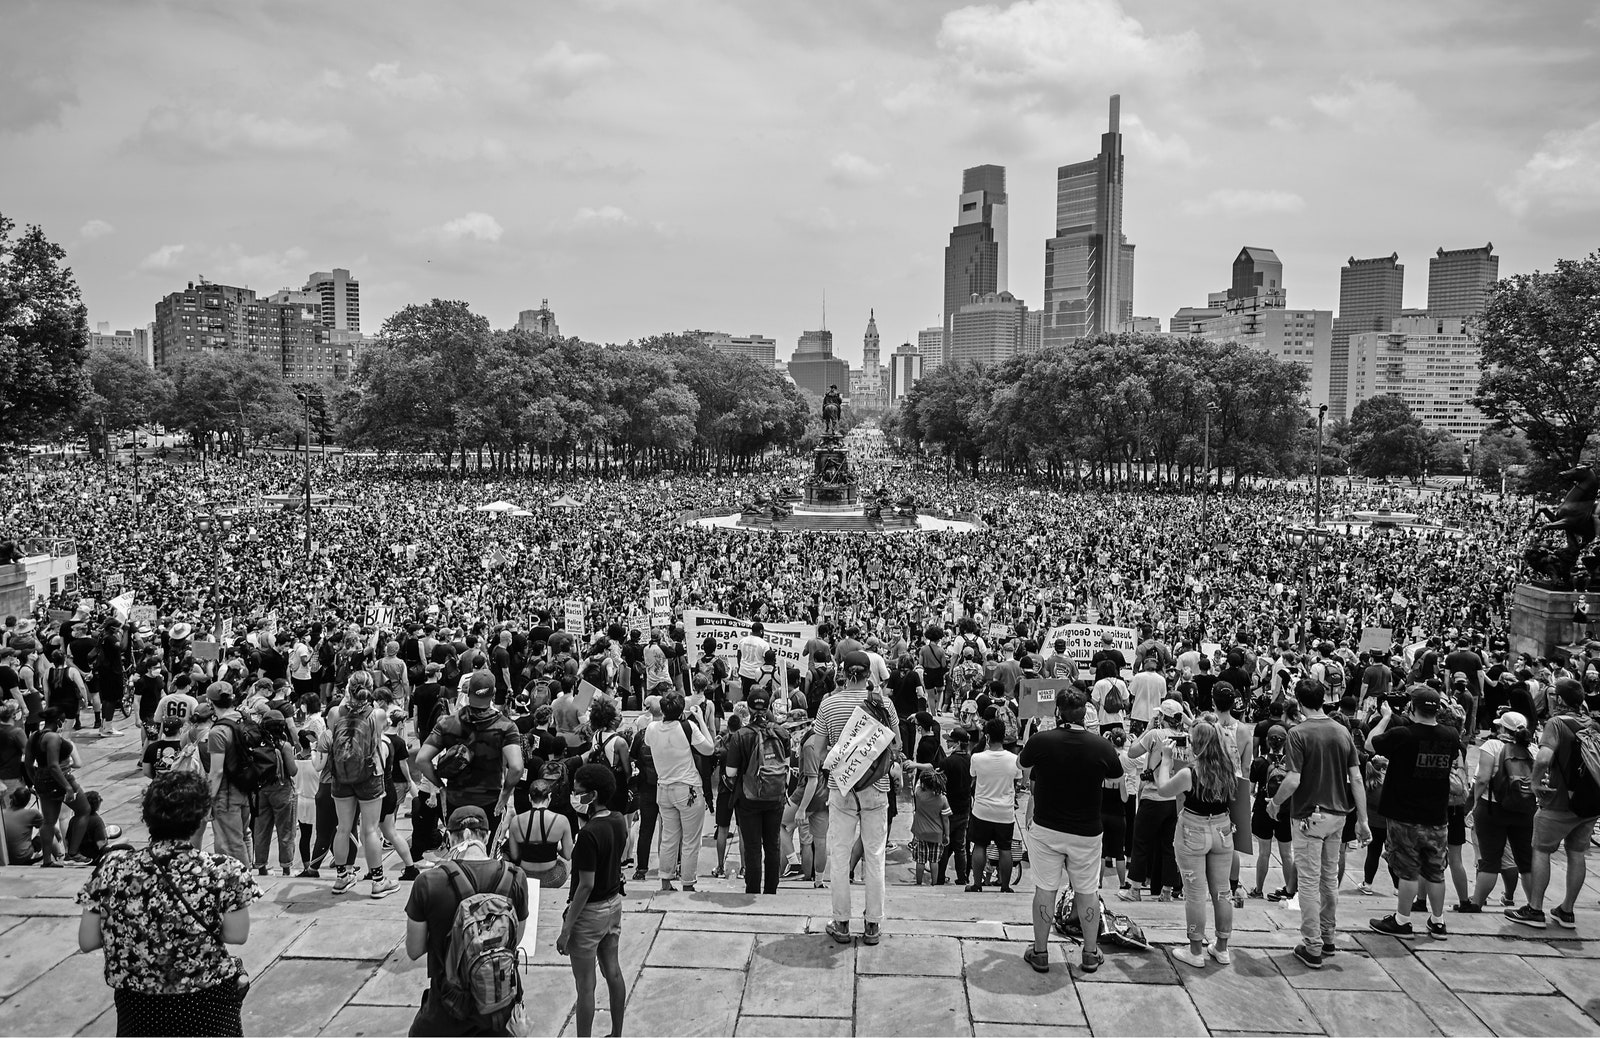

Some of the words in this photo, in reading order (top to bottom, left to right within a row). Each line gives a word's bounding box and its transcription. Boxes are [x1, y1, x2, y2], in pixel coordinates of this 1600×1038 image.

[653, 596, 668, 607] NOT
[166, 701, 188, 718] 66
[850, 714, 870, 737] WATER
[839, 758, 862, 785] SAFETY
[860, 728, 884, 757] GLASSES
[1418, 755, 1449, 767] LIVES
